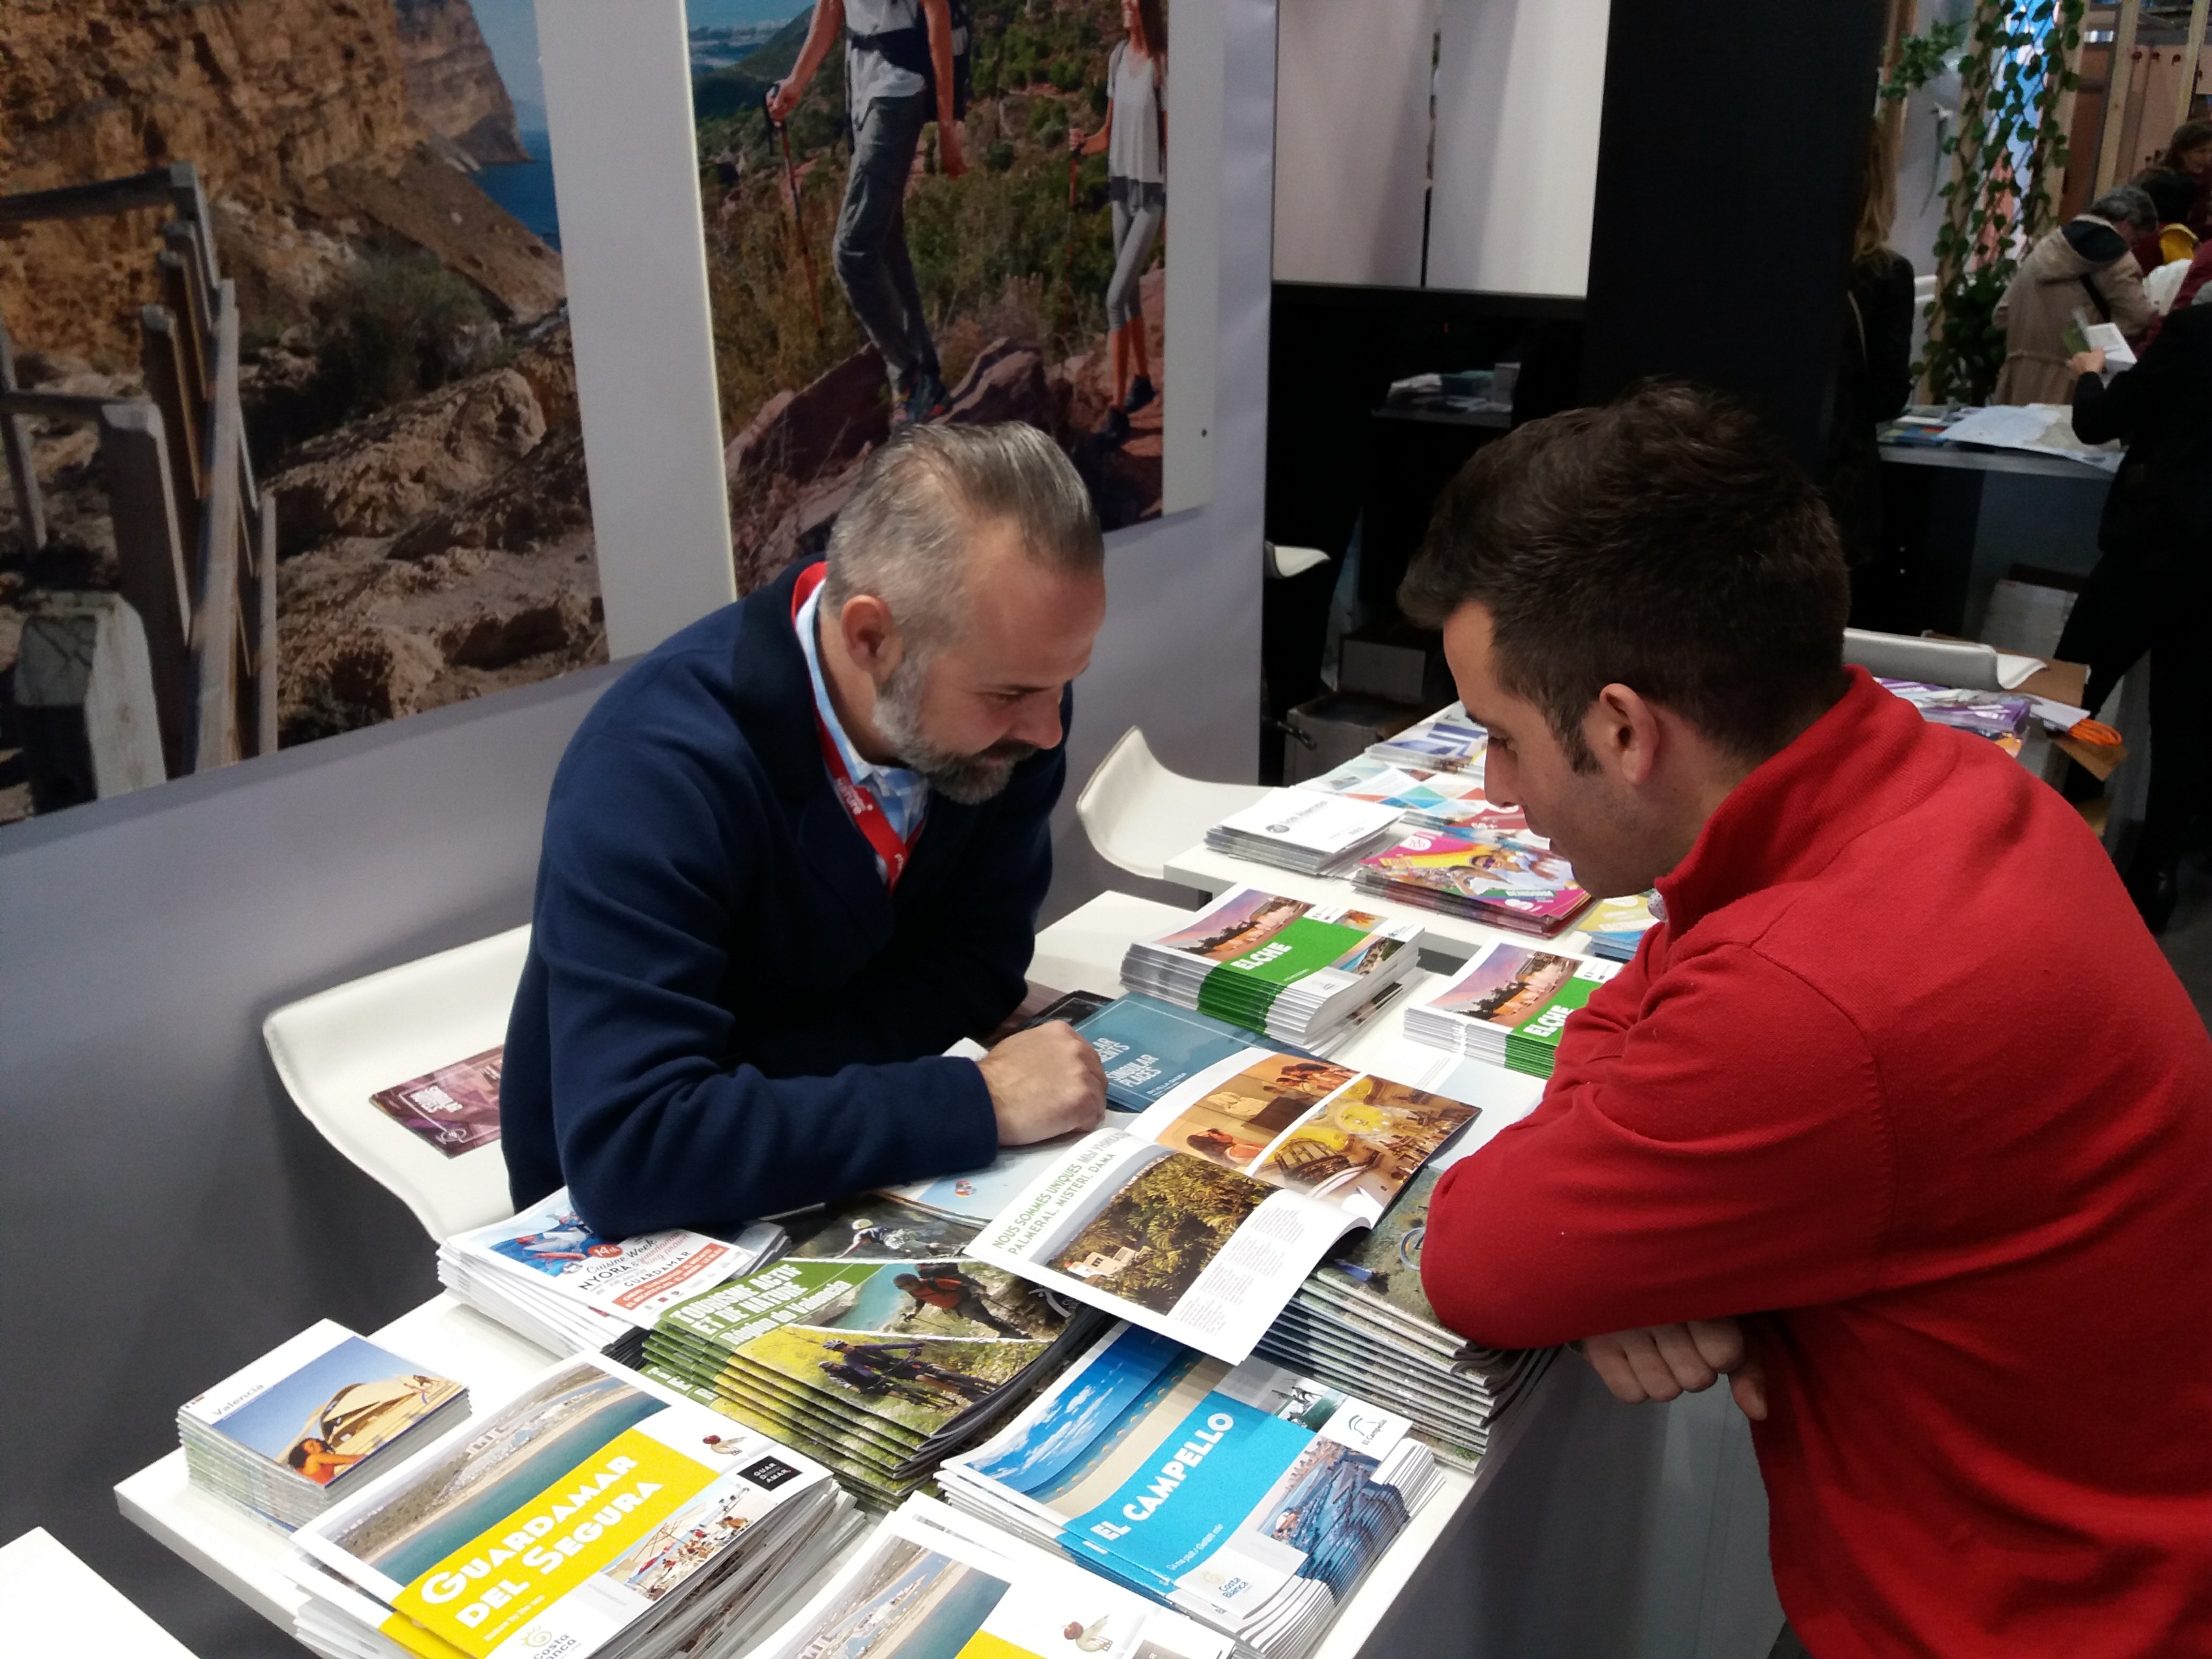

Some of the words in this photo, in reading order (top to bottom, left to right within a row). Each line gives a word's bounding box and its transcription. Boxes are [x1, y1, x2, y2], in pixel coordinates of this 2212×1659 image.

[1230, 942, 1292, 970] ELCHE
[1523, 1005, 1574, 1037] ELCHE
[1107, 1054, 1159, 1082] SINGULAR
[1119, 1067, 1162, 1087] PLACES
[992, 1224, 1020, 1249] NOUS
[1015, 1192, 1052, 1226] SOMMES
[1046, 1164, 1082, 1194] UNIQUES
[1007, 1207, 1060, 1255] PALMERAL,
[1055, 1173, 1094, 1207] MISTERI,
[1088, 1153, 1117, 1172] DAMA
[587, 1256, 627, 1274] Cuisine
[627, 1238, 657, 1258] Week
[624, 1251, 692, 1287] GUARDAMAR
[578, 1265, 633, 1290] NYORA
[669, 1284, 759, 1324] TOURISME
[749, 1264, 802, 1291] ACTIF
[691, 1317, 725, 1335] ET
[714, 1305, 750, 1323] DE
[739, 1281, 809, 1314] NATURE
[771, 1307, 798, 1323] de
[785, 1280, 853, 1315] Valencia
[212, 1385, 264, 1415] Valencia
[1366, 1419, 1387, 1440] Campello
[753, 1463, 777, 1476] GUAR
[766, 1469, 787, 1483] AMAR
[1090, 1520, 1132, 1540] EL
[1122, 1413, 1234, 1520] CAMPELLO
[421, 1455, 639, 1604] GUARDAMAR
[522, 1482, 664, 1575] SEGURA
[1219, 1577, 1241, 1592] Costa
[1222, 1581, 1249, 1598] Blanca
[454, 1579, 531, 1629] DEL
[545, 1638, 577, 1659] anca
